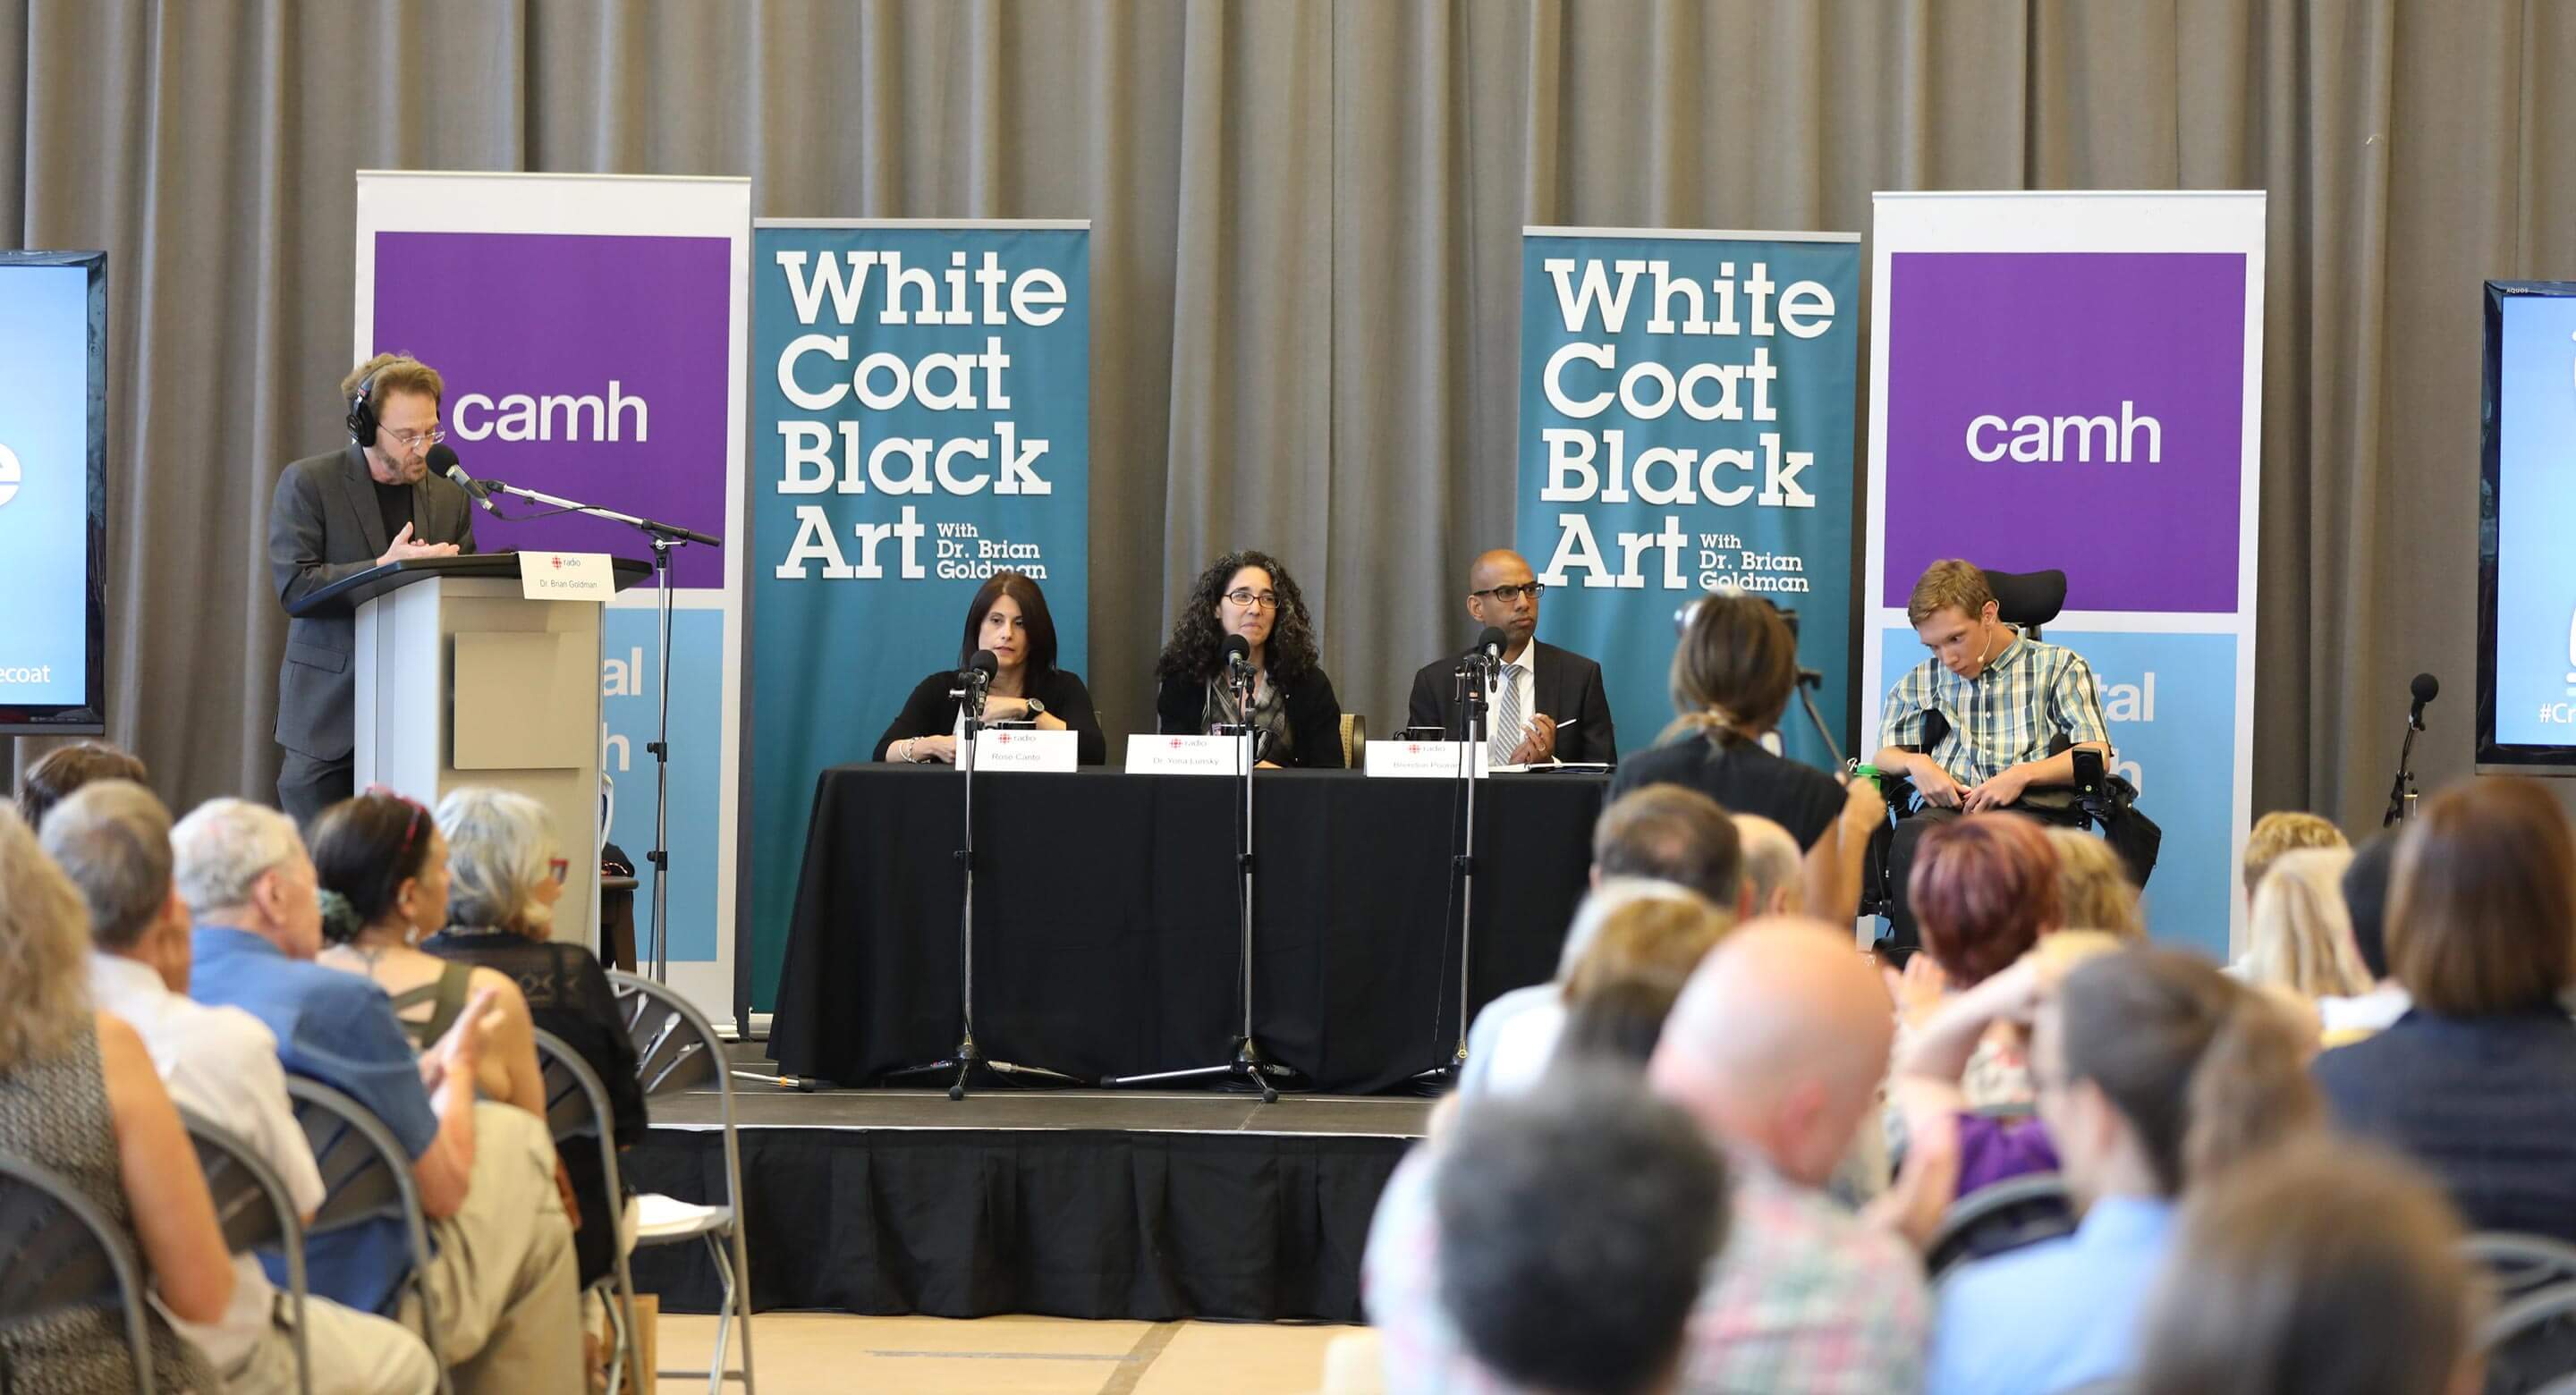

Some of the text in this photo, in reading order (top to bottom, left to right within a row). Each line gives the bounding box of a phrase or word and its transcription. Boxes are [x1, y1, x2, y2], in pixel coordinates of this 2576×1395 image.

[776, 250, 1067, 326] White
[1544, 258, 1835, 339] White
[776, 334, 1013, 410] Coat
[1543, 342, 1777, 421] Coat
[453, 380, 648, 443] camh
[1965, 400, 2161, 463] camh
[776, 420, 1052, 495] Black
[1540, 428, 1817, 508] Black
[775, 505, 926, 579] Art
[936, 522, 979, 538] With
[936, 540, 1040, 560] Dr. Brian
[1537, 513, 1689, 590] Art
[1699, 534, 1741, 550] With
[1699, 551, 1803, 572] Dr. Brian
[550, 579, 568, 588] Brian
[569, 579, 597, 588] Goldman
[563, 557, 581, 567] radio
[1699, 571, 1809, 593] Goldman
[1013, 733, 1037, 742] radio
